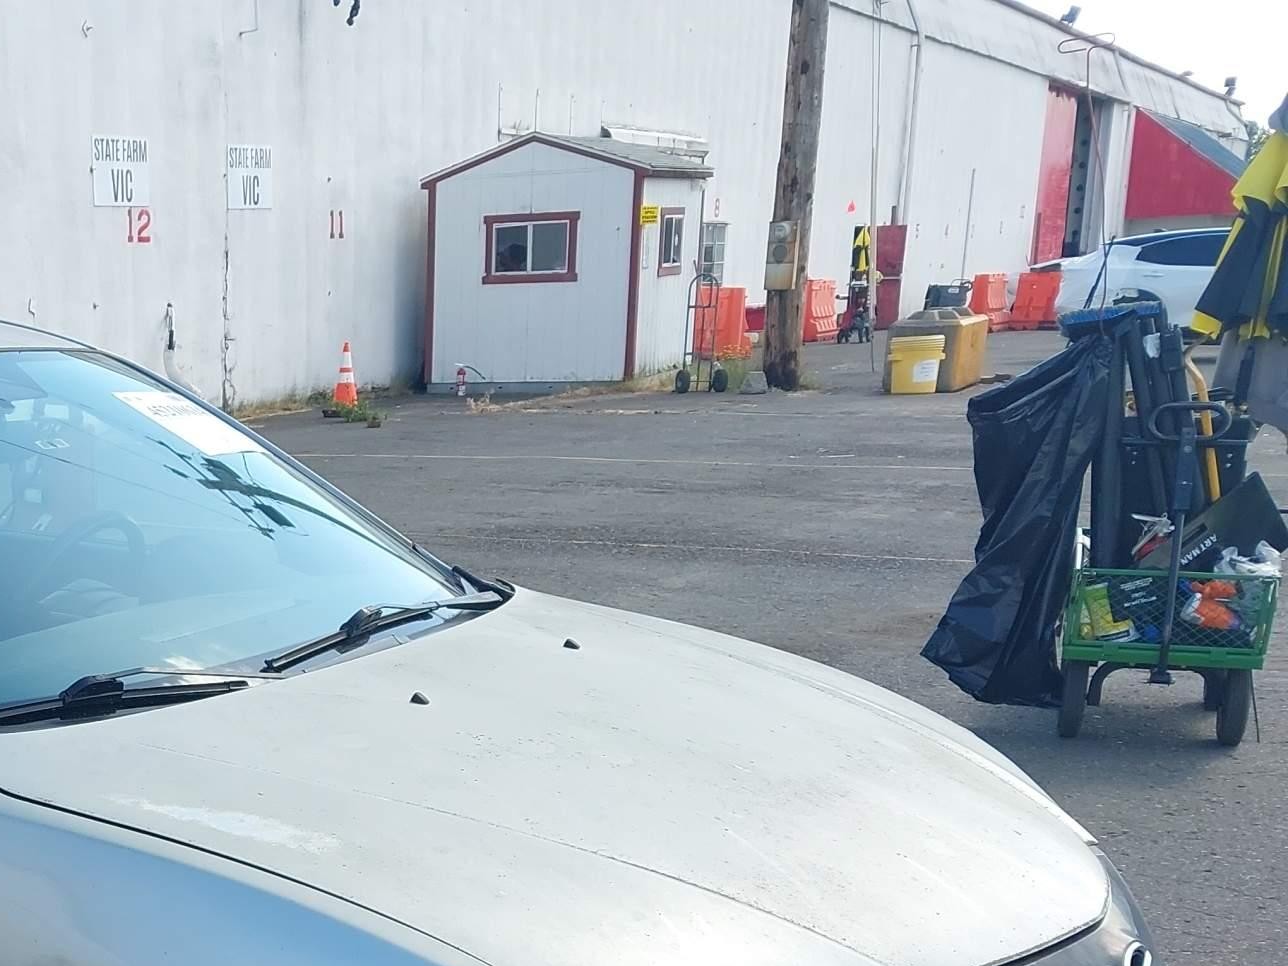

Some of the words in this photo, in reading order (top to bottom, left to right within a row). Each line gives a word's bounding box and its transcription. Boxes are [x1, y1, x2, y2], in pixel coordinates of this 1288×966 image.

[93, 138, 121, 162] STATE
[122, 140, 148, 163] FARM
[228, 147, 250, 169] STATE
[250, 148, 272, 169] FARM
[111, 168, 134, 203] VIC
[241, 174, 260, 206] VIC
[127, 206, 151, 243] 12
[329, 209, 345, 239] 11
